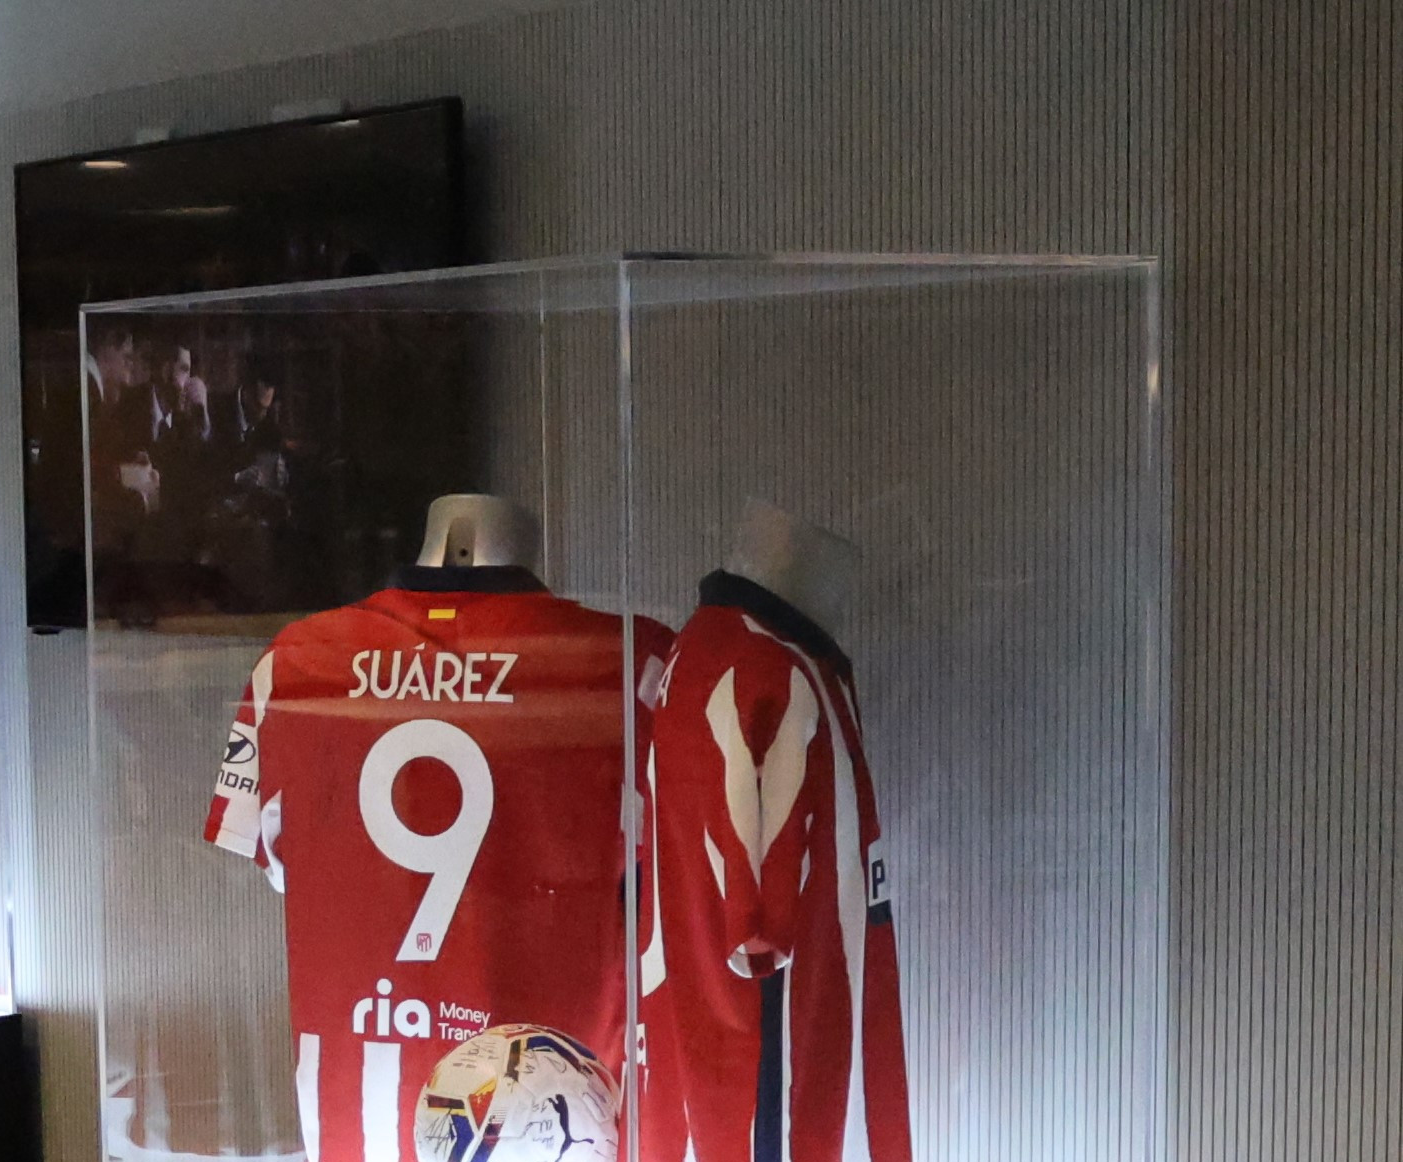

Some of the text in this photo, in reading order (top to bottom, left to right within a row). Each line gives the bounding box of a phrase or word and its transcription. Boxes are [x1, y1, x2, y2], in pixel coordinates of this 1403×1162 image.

[348, 641, 519, 703] SUÁREZ
[358, 718, 495, 962] 9
[352, 978, 431, 1038] ria
[439, 1001, 491, 1028] Money
